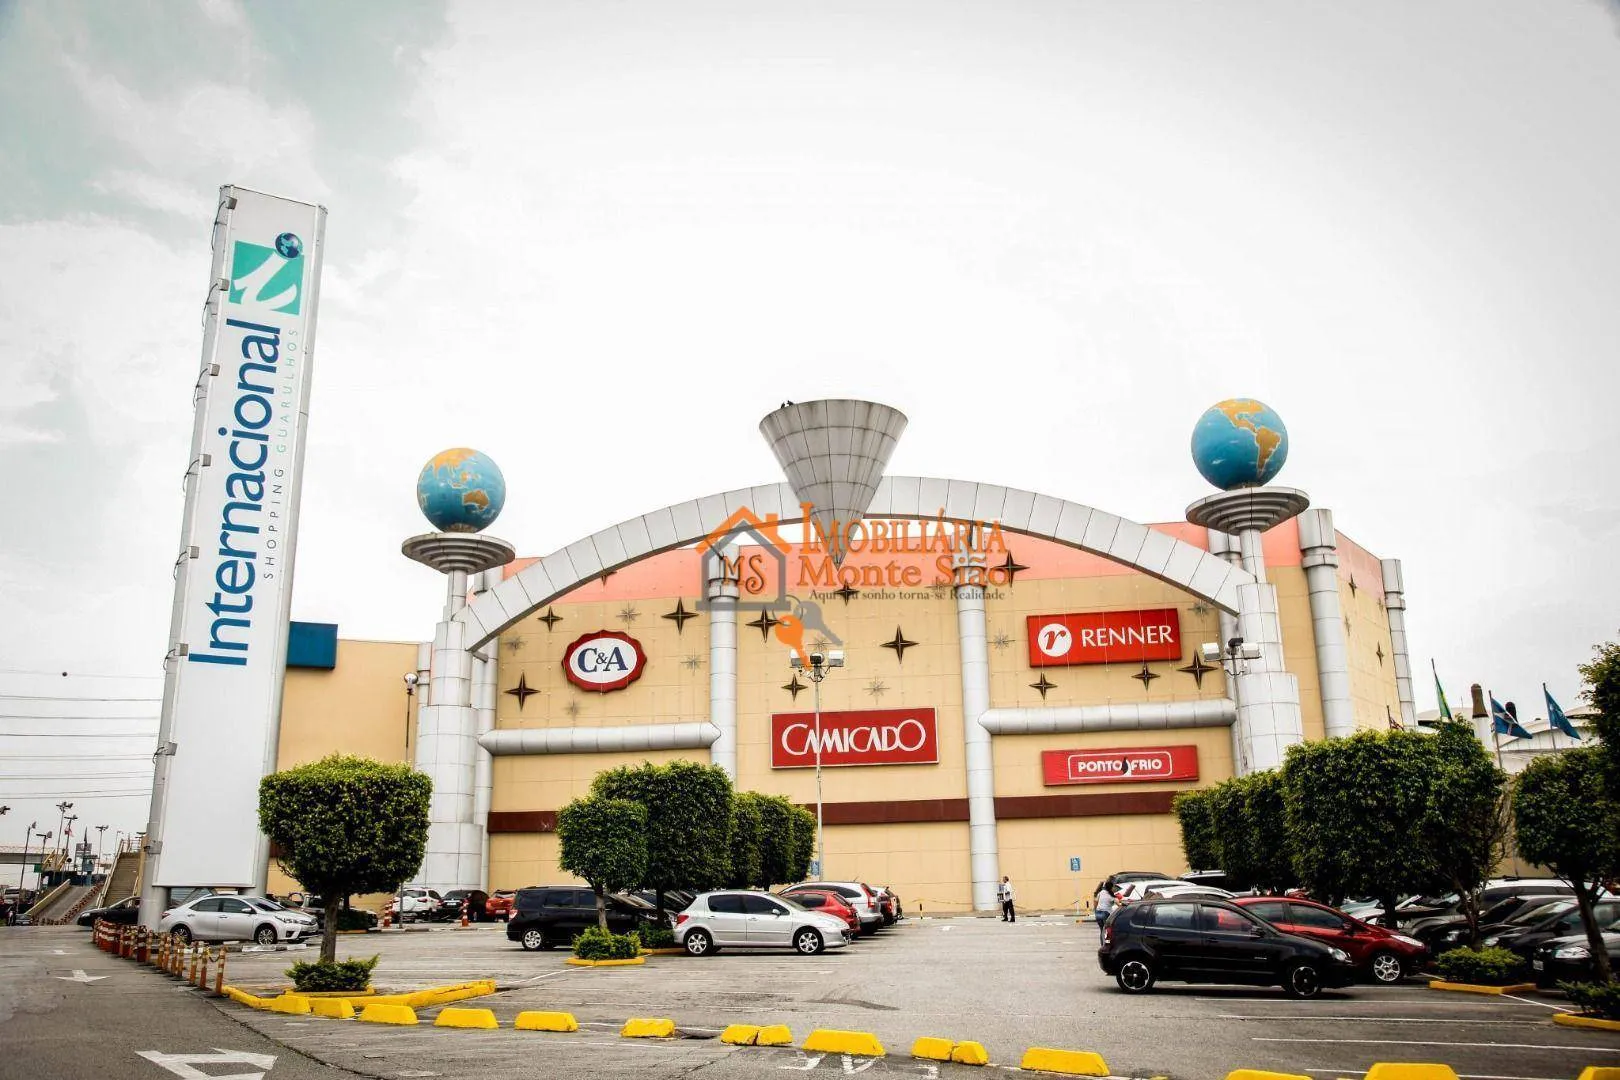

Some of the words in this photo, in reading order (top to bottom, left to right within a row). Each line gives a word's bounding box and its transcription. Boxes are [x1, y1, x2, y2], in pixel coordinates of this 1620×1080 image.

[263, 467, 284, 580] SHOPPING
[275, 327, 299, 454] GUARULHOS
[188, 317, 282, 666] Internacional
[1081, 625, 1174, 648] RENNER
[577, 645, 629, 673] C&A
[781, 718, 927, 756] CAMICADO
[1077, 759, 1122, 772] PONTO
[1129, 758, 1163, 771] FRIO
